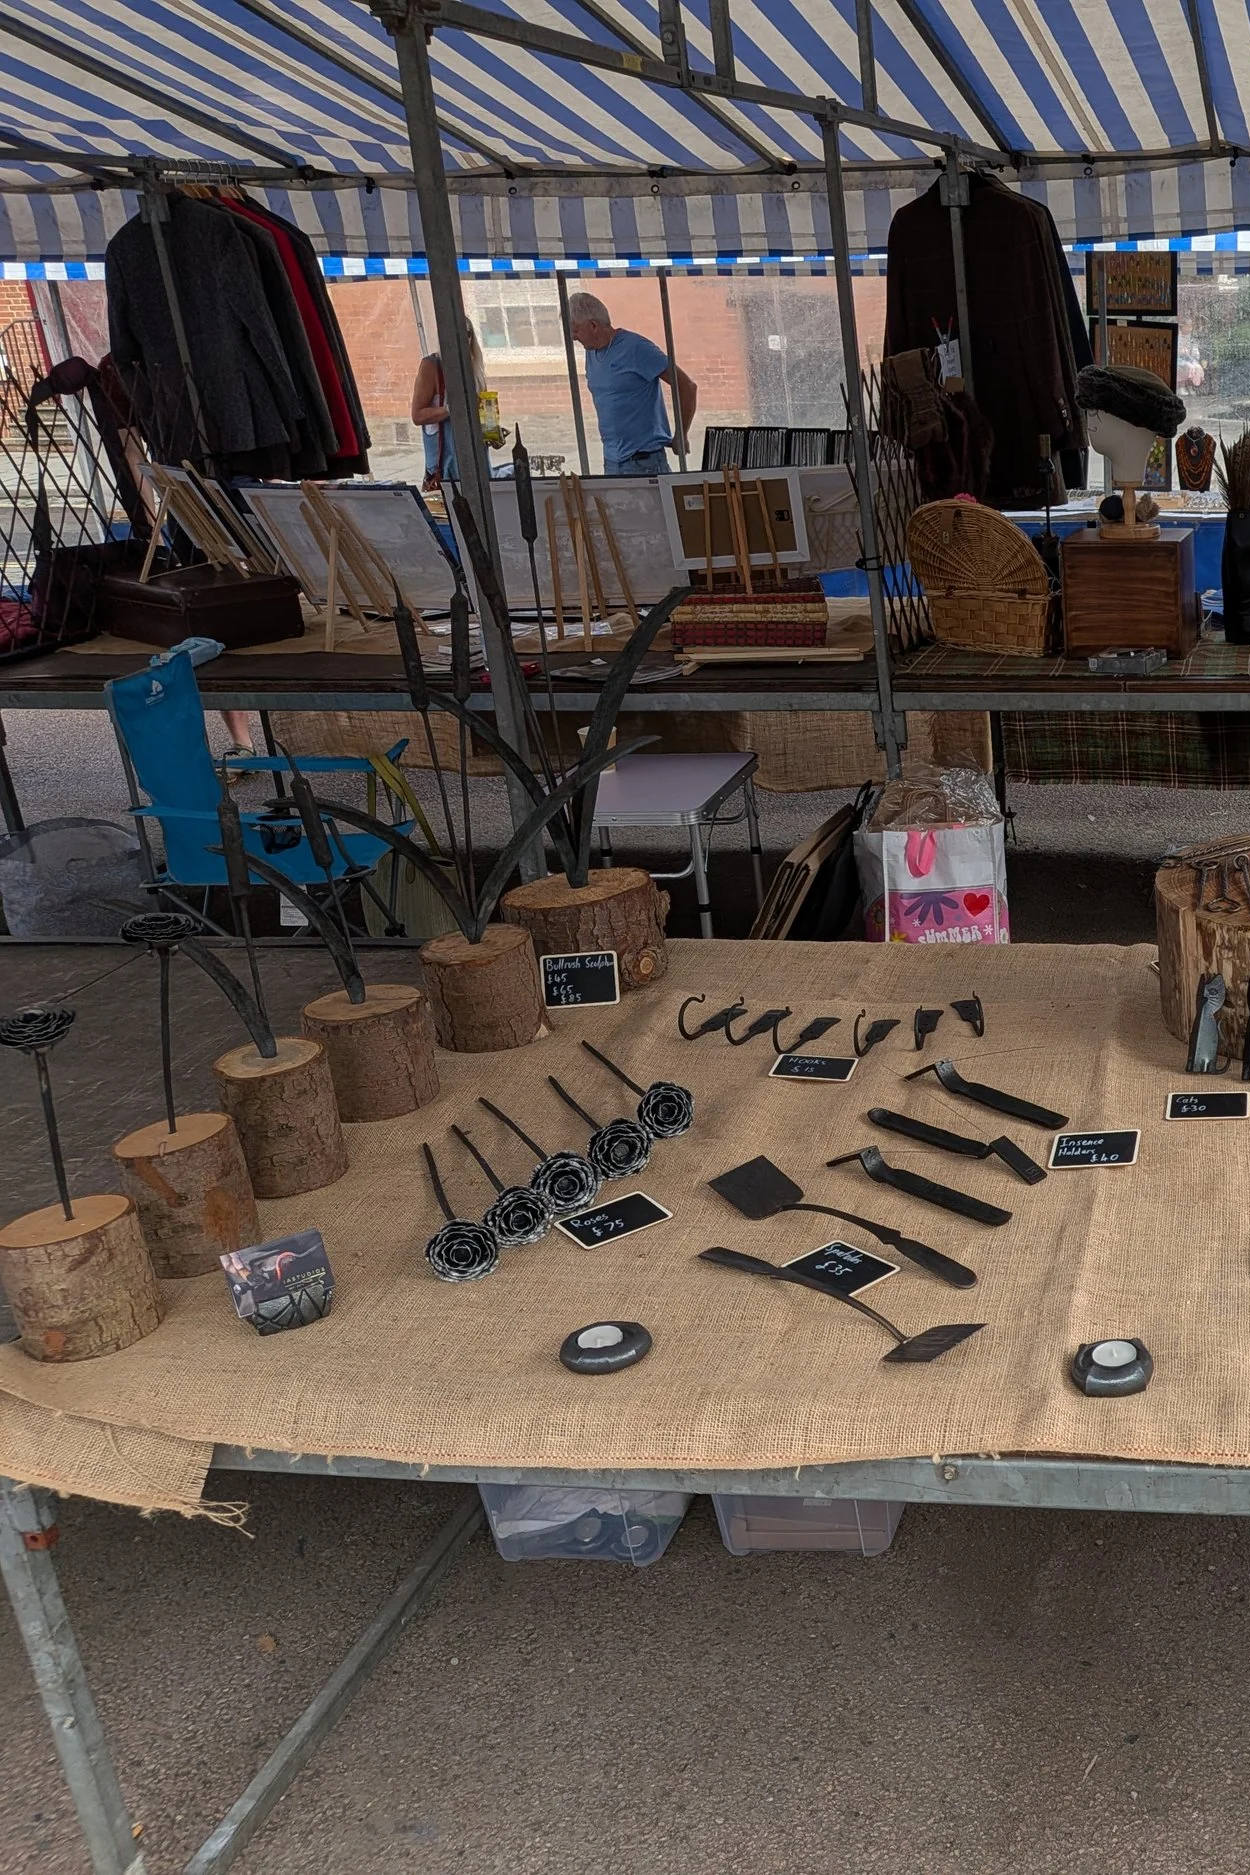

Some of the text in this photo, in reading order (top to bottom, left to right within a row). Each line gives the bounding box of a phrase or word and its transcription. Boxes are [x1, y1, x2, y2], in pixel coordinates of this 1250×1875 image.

[546, 957, 581, 972] Bullrush
[547, 973, 568, 985] £45
[552, 984, 574, 997] £65
[560, 993, 582, 1005] £85
[1176, 1096, 1199, 1104] Cats
[1180, 1104, 1207, 1113] £30
[570, 1213, 609, 1229] Roses
